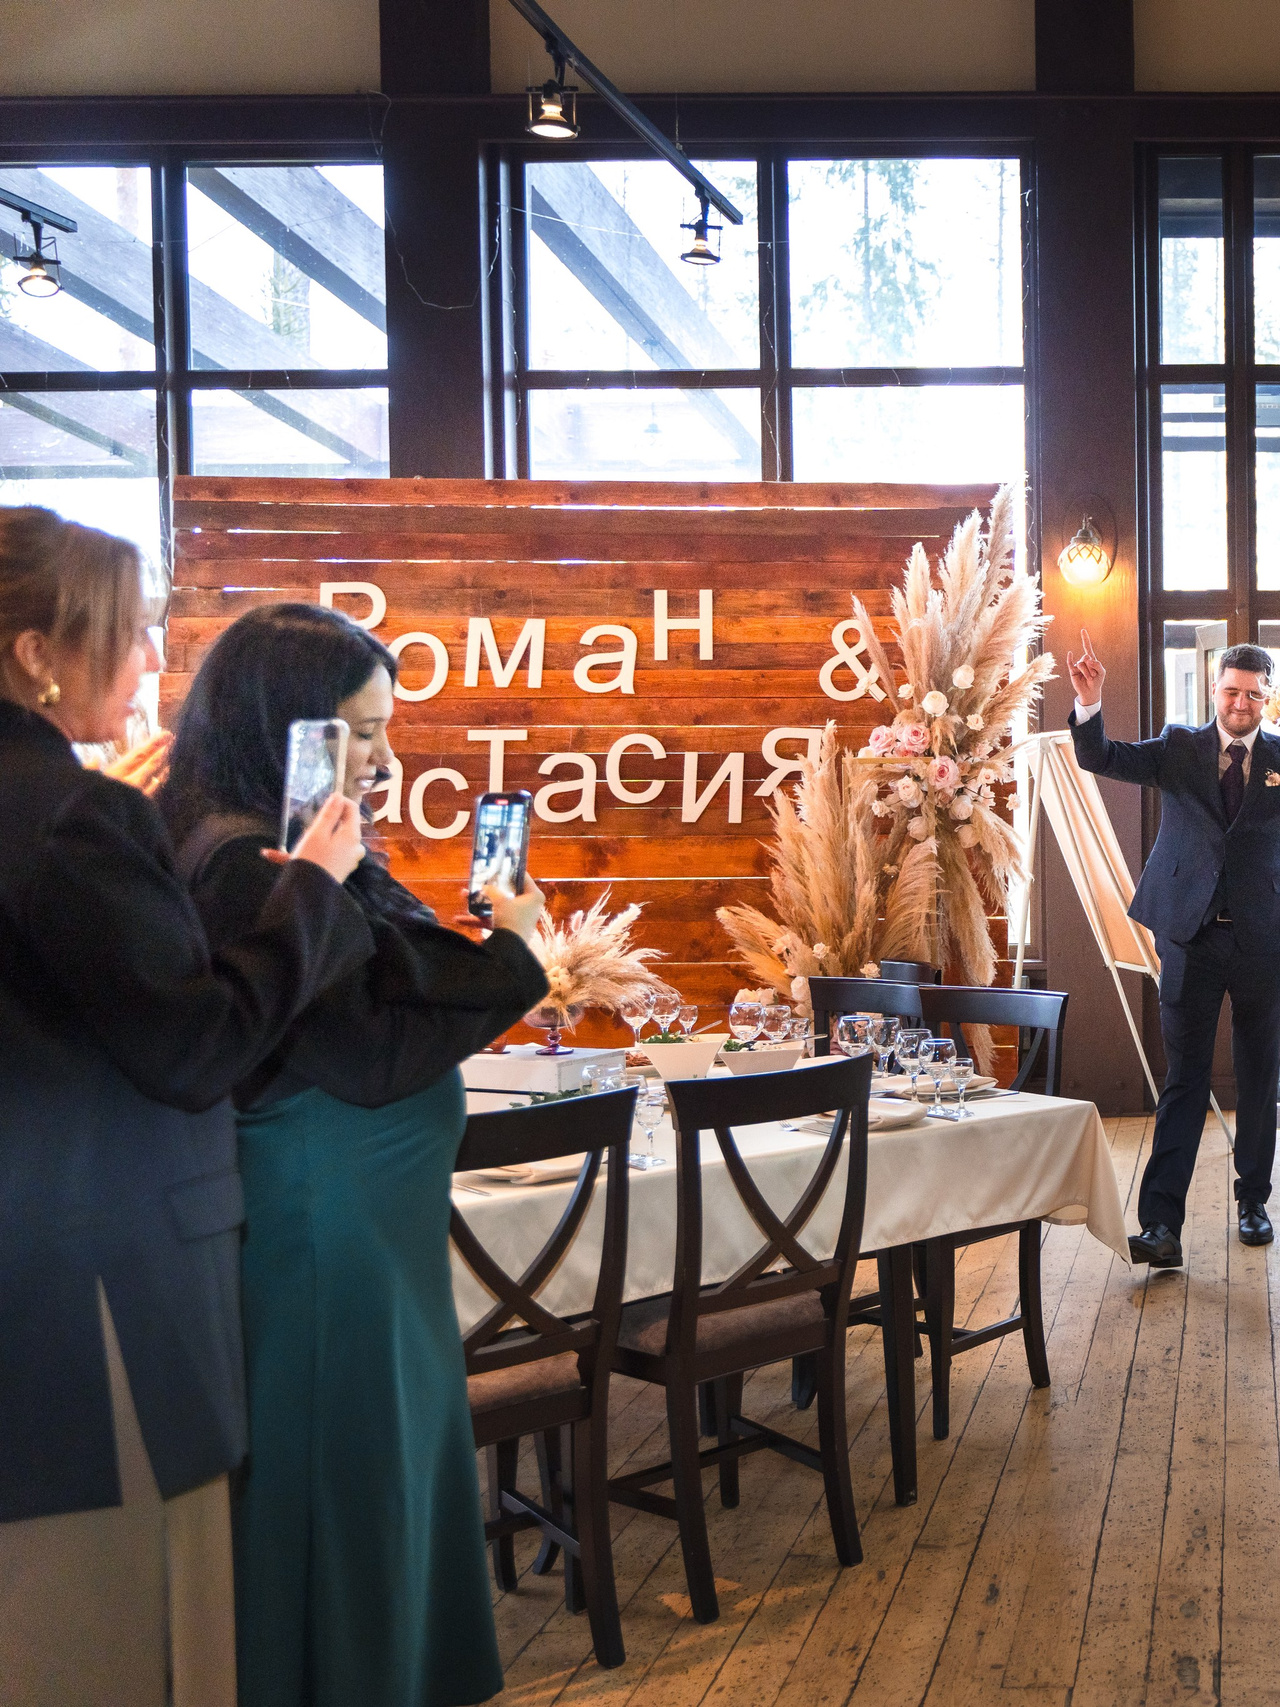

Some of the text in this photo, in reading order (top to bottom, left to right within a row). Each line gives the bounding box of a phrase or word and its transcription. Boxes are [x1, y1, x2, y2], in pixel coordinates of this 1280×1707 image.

[319, 581, 887, 702] Роман &
[360, 727, 822, 840] астасия
